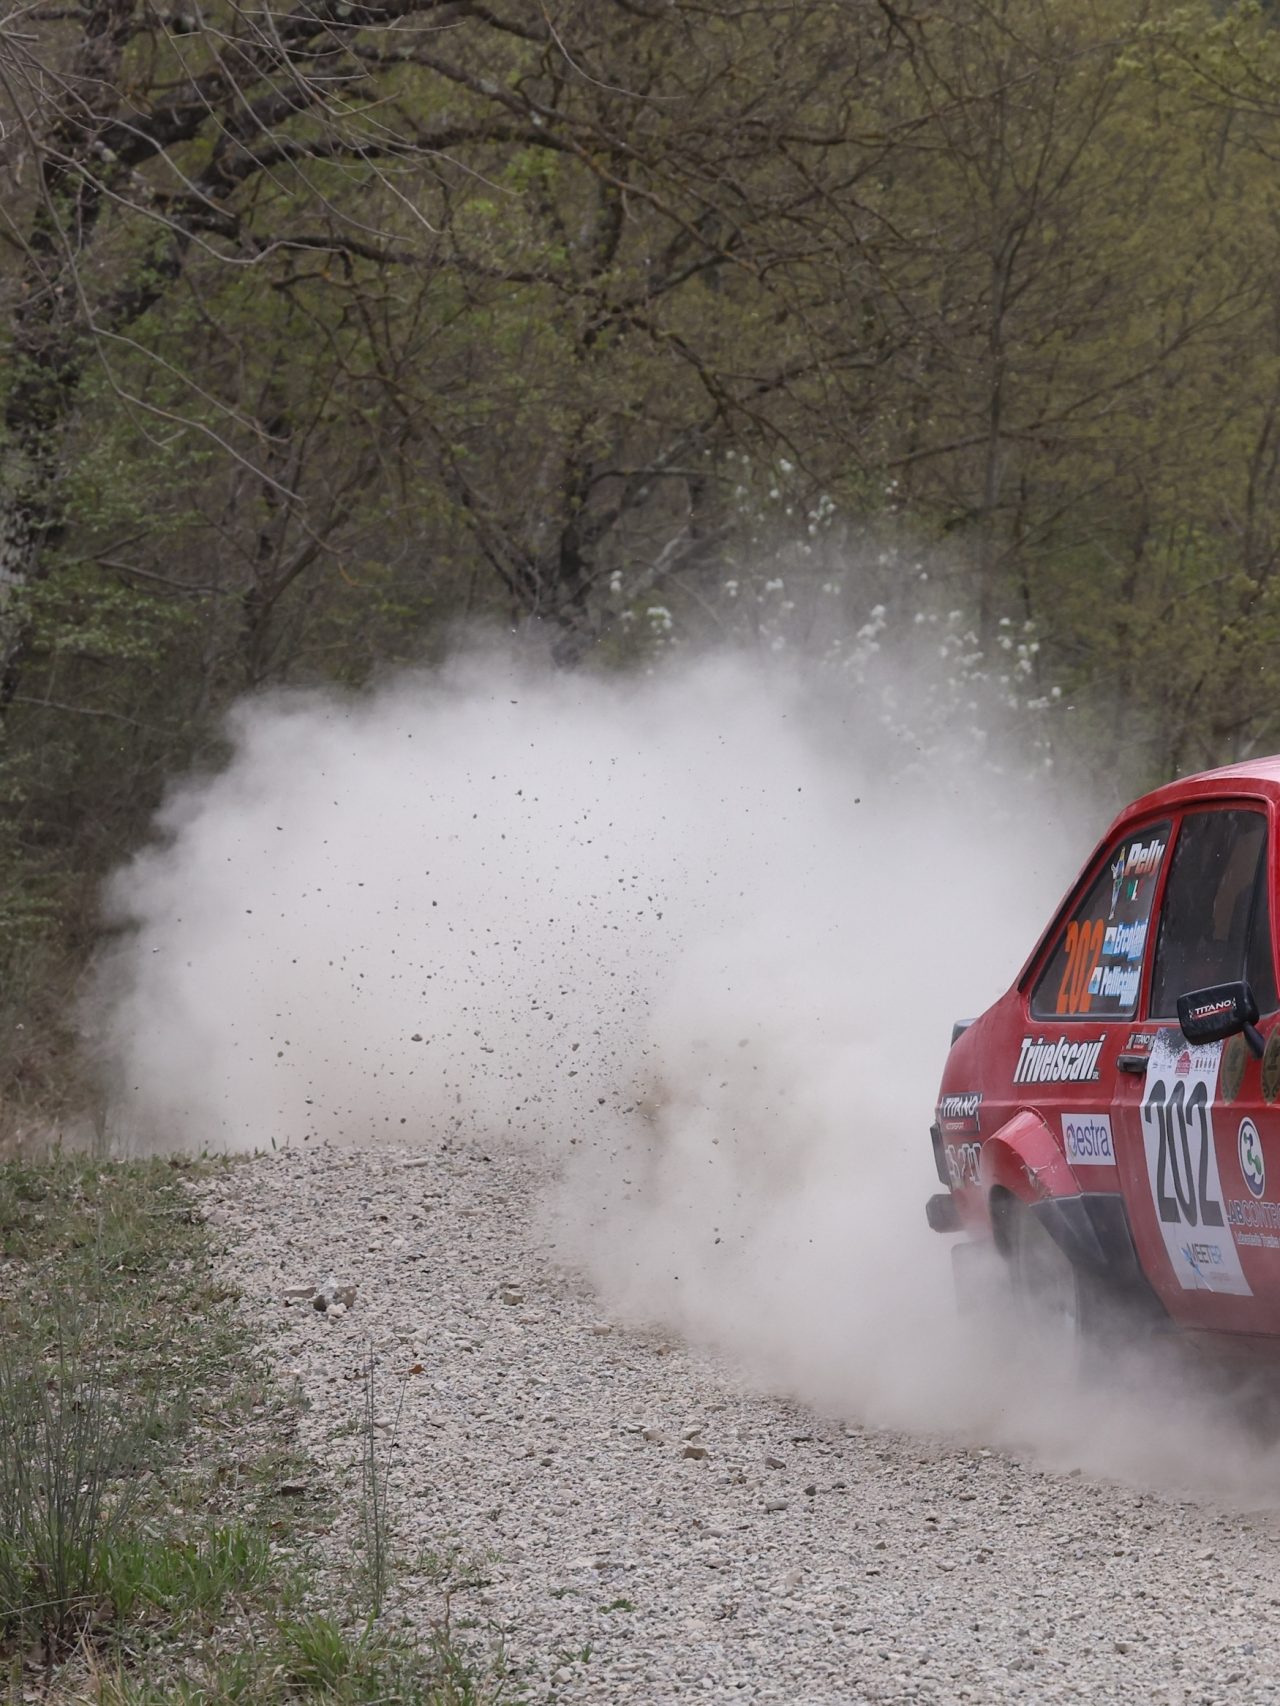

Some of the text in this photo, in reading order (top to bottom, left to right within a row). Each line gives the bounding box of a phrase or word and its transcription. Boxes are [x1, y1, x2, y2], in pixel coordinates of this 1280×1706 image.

[1056, 919, 1104, 1014] 202
[1195, 1000, 1232, 1015] TITANO
[1013, 1034, 1106, 1083] Trivelscavi
[943, 1095, 979, 1117] TITANO
[1144, 1079, 1225, 1227] 202
